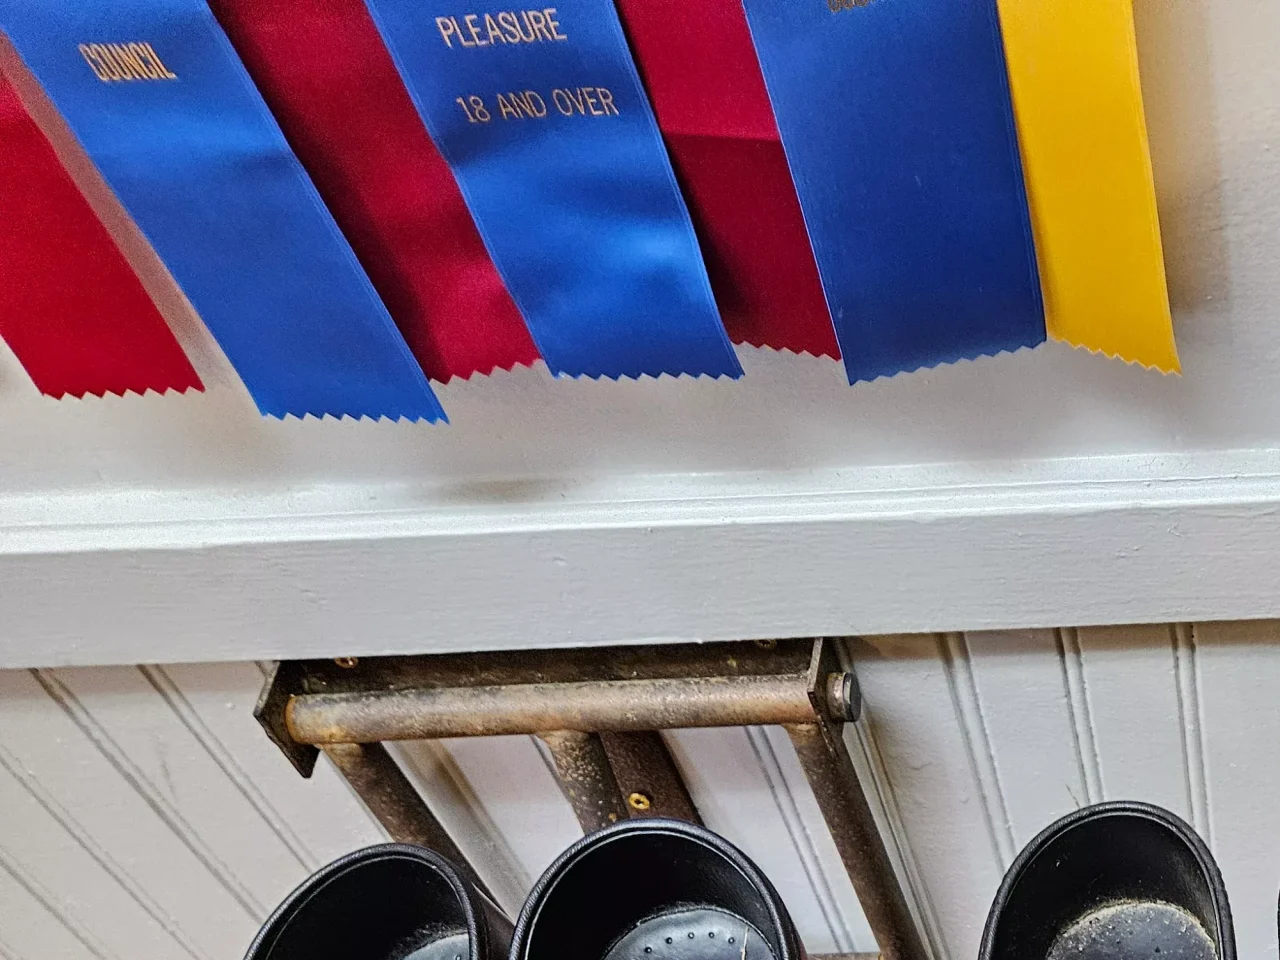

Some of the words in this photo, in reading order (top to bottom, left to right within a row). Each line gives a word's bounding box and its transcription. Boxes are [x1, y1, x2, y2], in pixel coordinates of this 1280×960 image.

[435, 7, 568, 48] PLEASURE
[79, 42, 178, 81] COUNCIL
[456, 95, 491, 123] 18
[496, 90, 547, 120] AND
[552, 87, 620, 116] OVER
